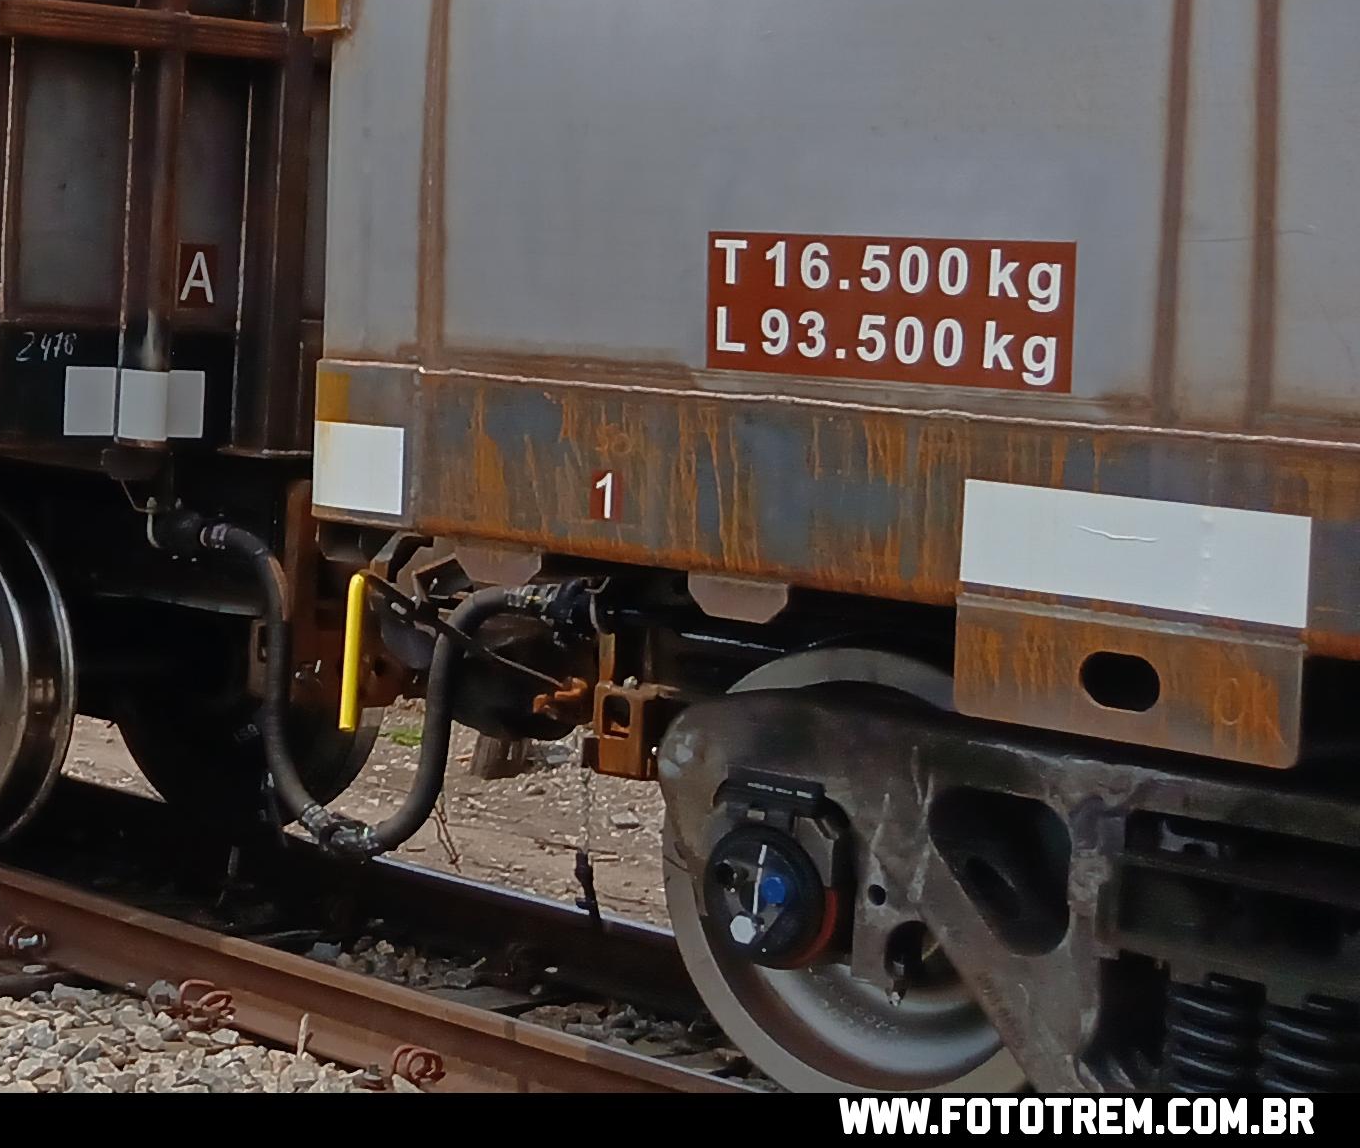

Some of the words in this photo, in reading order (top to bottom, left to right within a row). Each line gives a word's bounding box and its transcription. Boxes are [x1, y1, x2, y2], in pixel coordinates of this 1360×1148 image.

[180, 251, 214, 303] A
[715, 239, 748, 284] T
[765, 241, 969, 295] 16.500
[988, 249, 1062, 313] kg
[716, 306, 746, 352] L
[761, 308, 964, 367] 93.500
[982, 320, 1057, 386] kg
[595, 472, 612, 519] 1
